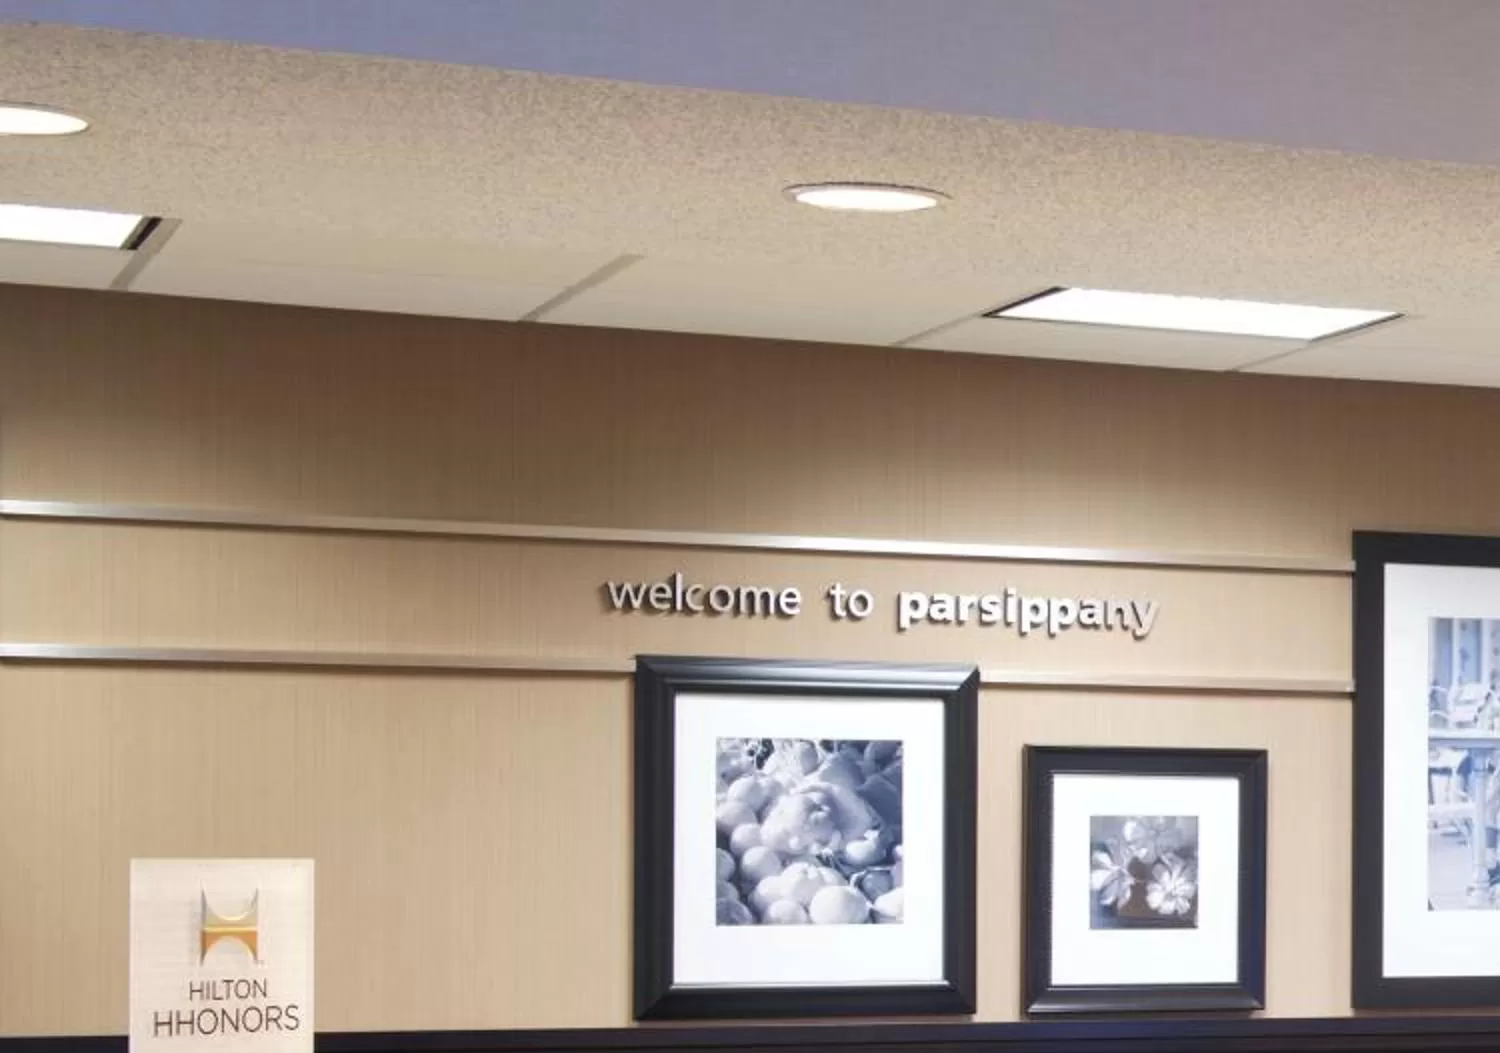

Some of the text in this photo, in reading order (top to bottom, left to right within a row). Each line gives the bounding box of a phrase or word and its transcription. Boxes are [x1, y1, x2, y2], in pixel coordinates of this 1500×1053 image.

[606, 571, 1161, 638] welcome to parsippany
[188, 978, 268, 1002] HILTON
[153, 1004, 300, 1038] HHONORS
